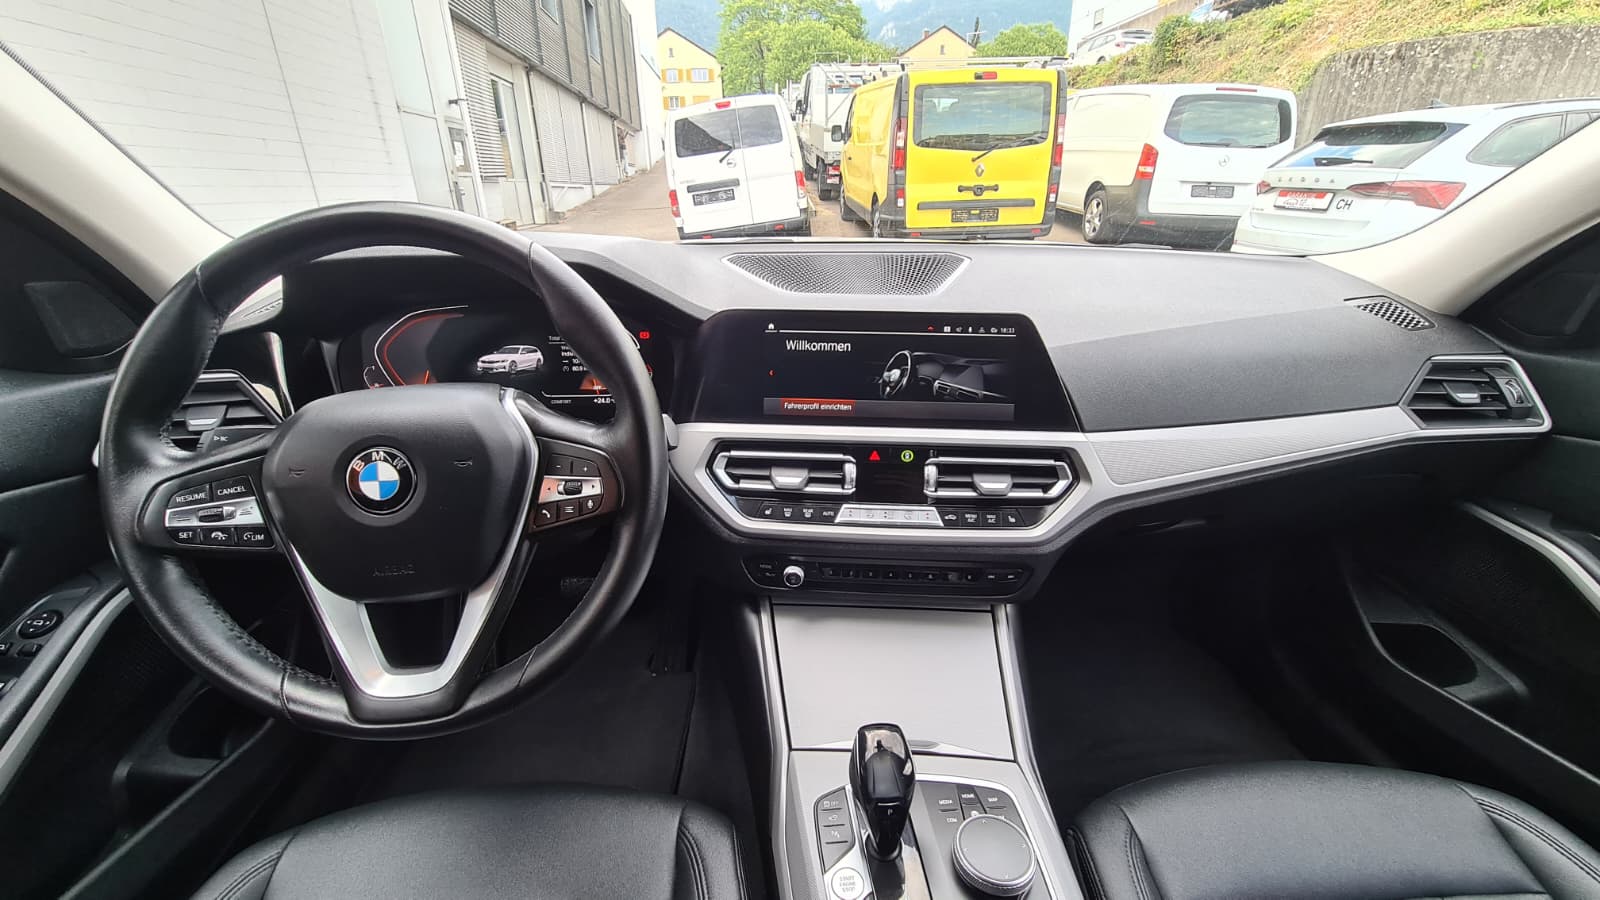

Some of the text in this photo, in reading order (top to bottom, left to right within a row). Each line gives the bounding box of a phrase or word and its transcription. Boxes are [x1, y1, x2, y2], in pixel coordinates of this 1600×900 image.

[1336, 198, 1354, 210] CH
[786, 339, 852, 352] Willkommen
[784, 402, 852, 411] Fahrerprofil einrichten
[352, 450, 407, 472] BMW
[217, 485, 246, 496] CANCEL
[175, 491, 207, 503] RESUME
[178, 531, 193, 539] SET
